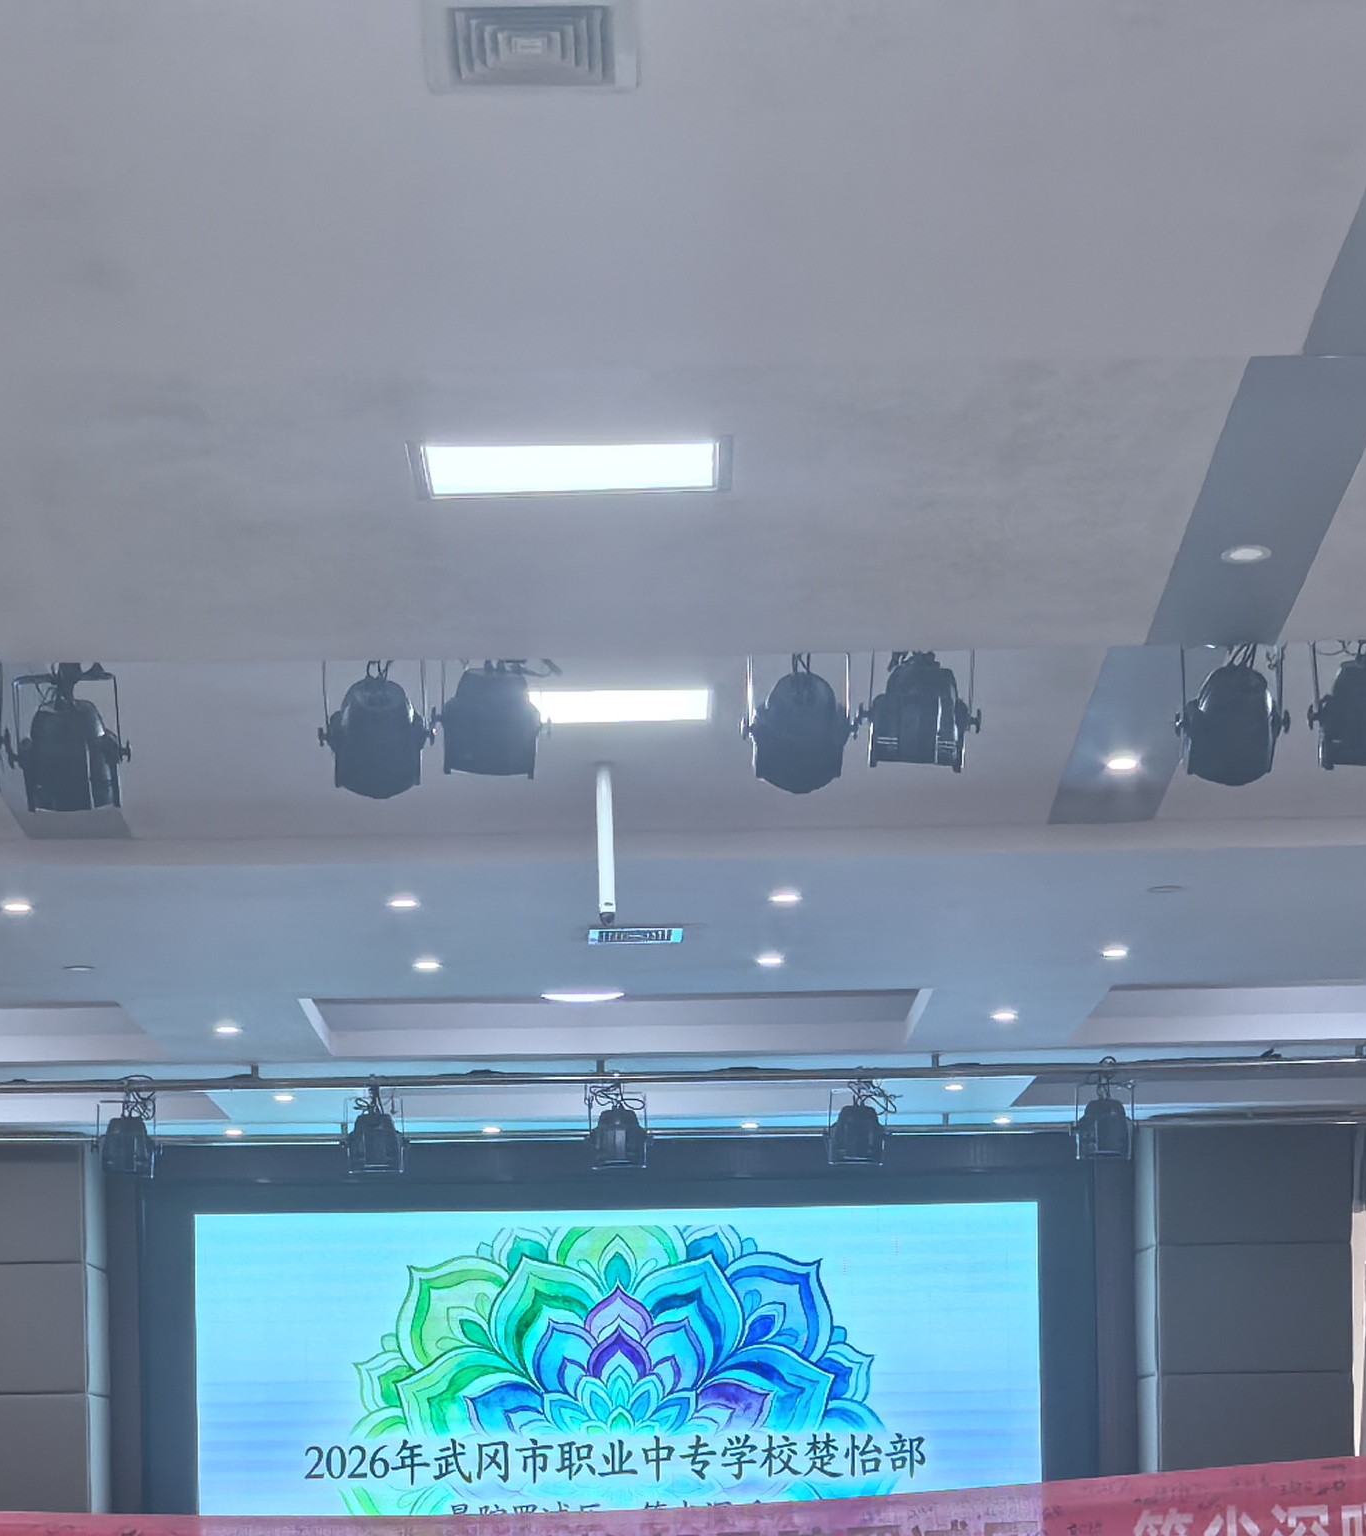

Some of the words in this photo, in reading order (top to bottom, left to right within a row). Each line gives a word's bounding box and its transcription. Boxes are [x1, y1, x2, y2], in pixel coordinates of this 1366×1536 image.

[304, 1437, 926, 1486] 2026年武冈市职业中专学校楚怡部
